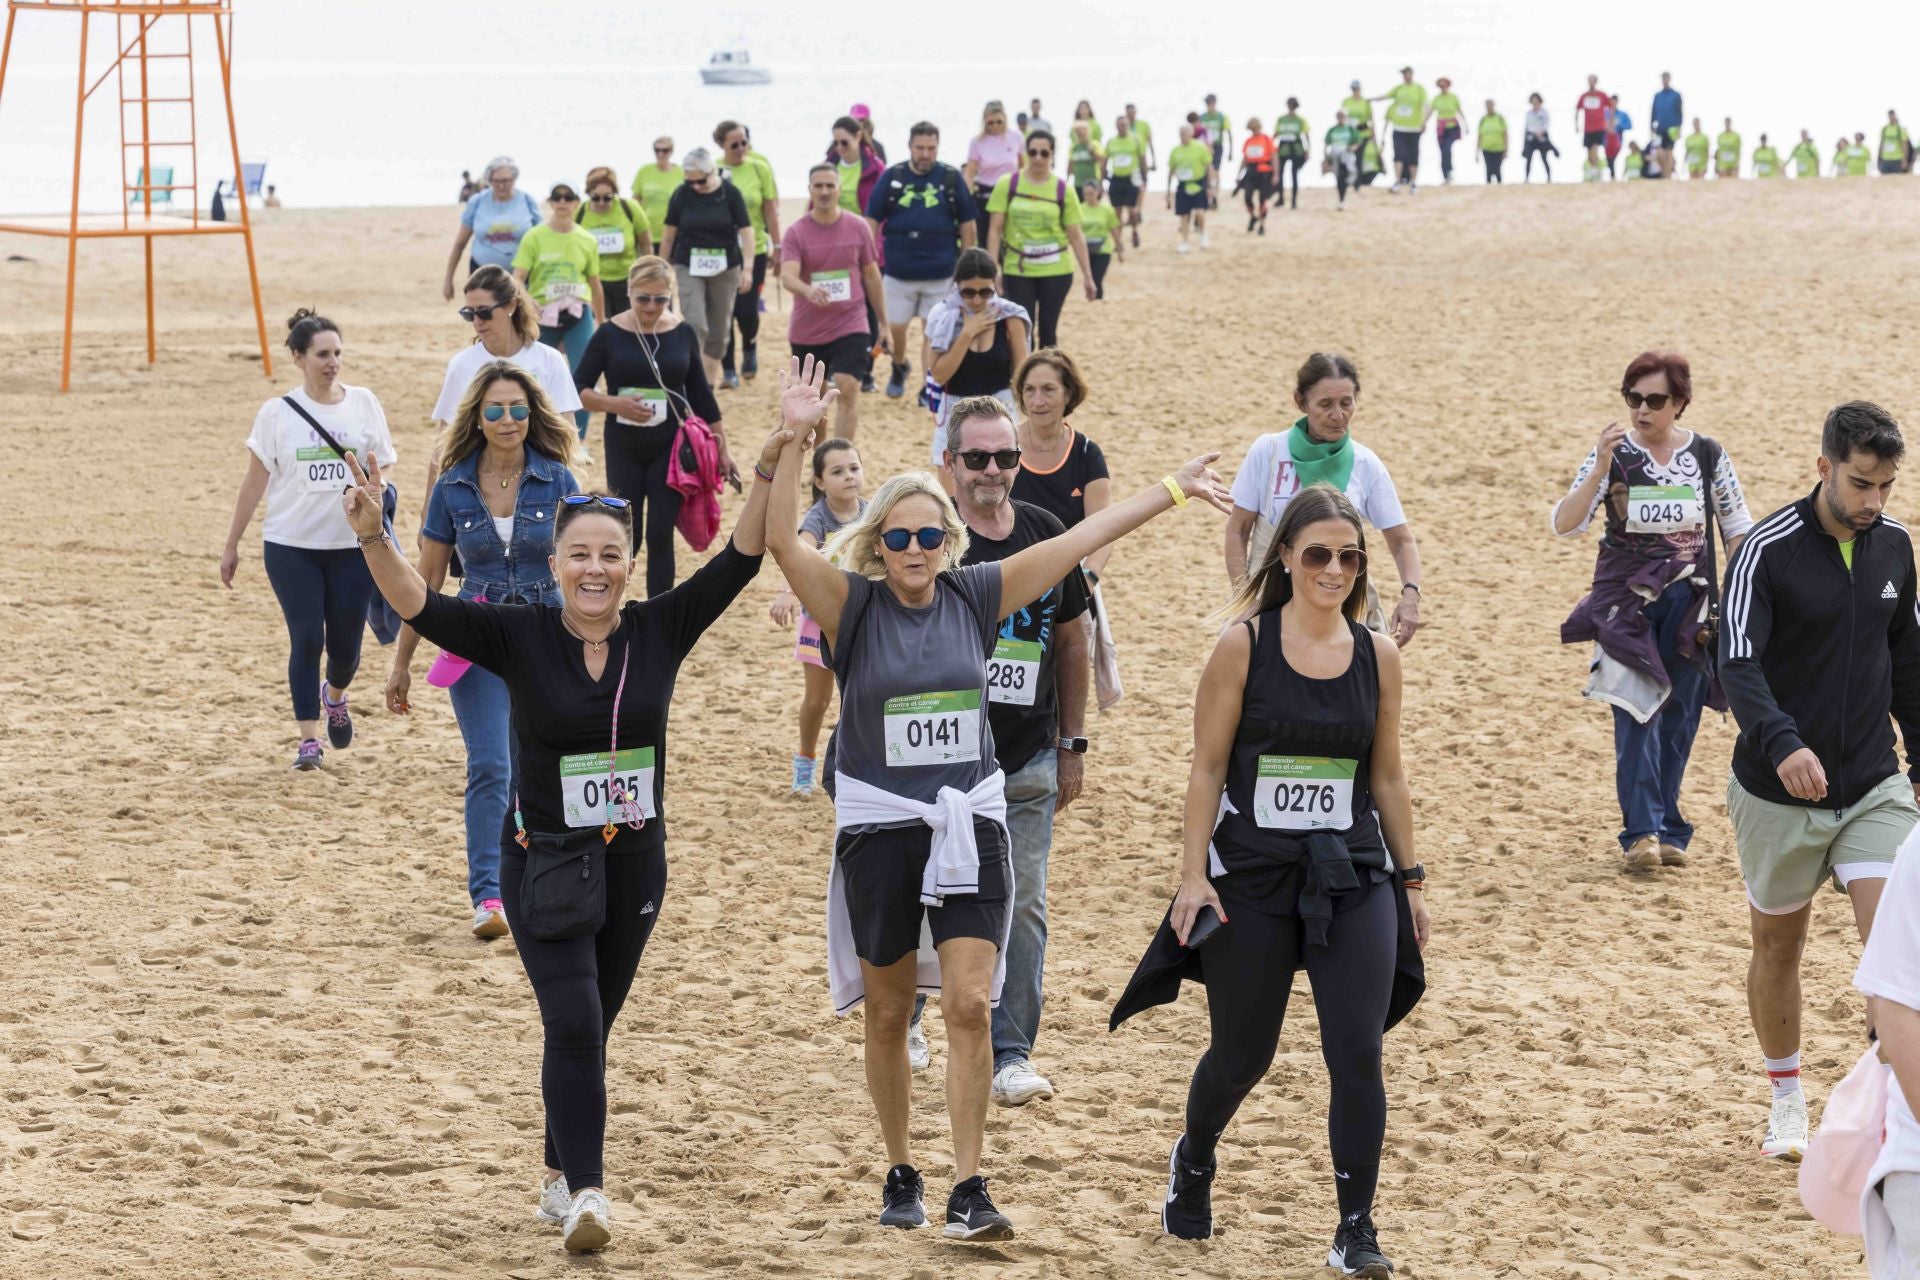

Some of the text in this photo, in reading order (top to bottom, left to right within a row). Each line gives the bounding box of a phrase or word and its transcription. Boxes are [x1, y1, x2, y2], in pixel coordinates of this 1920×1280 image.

[309, 463, 345, 481] 0270
[1640, 504, 1683, 523] 0243
[907, 718, 959, 747] 0141
[564, 753, 597, 762] Santander
[564, 761, 585, 769] contra
[1291, 763, 1313, 771] cáncer
[1274, 783, 1335, 813] 0276
